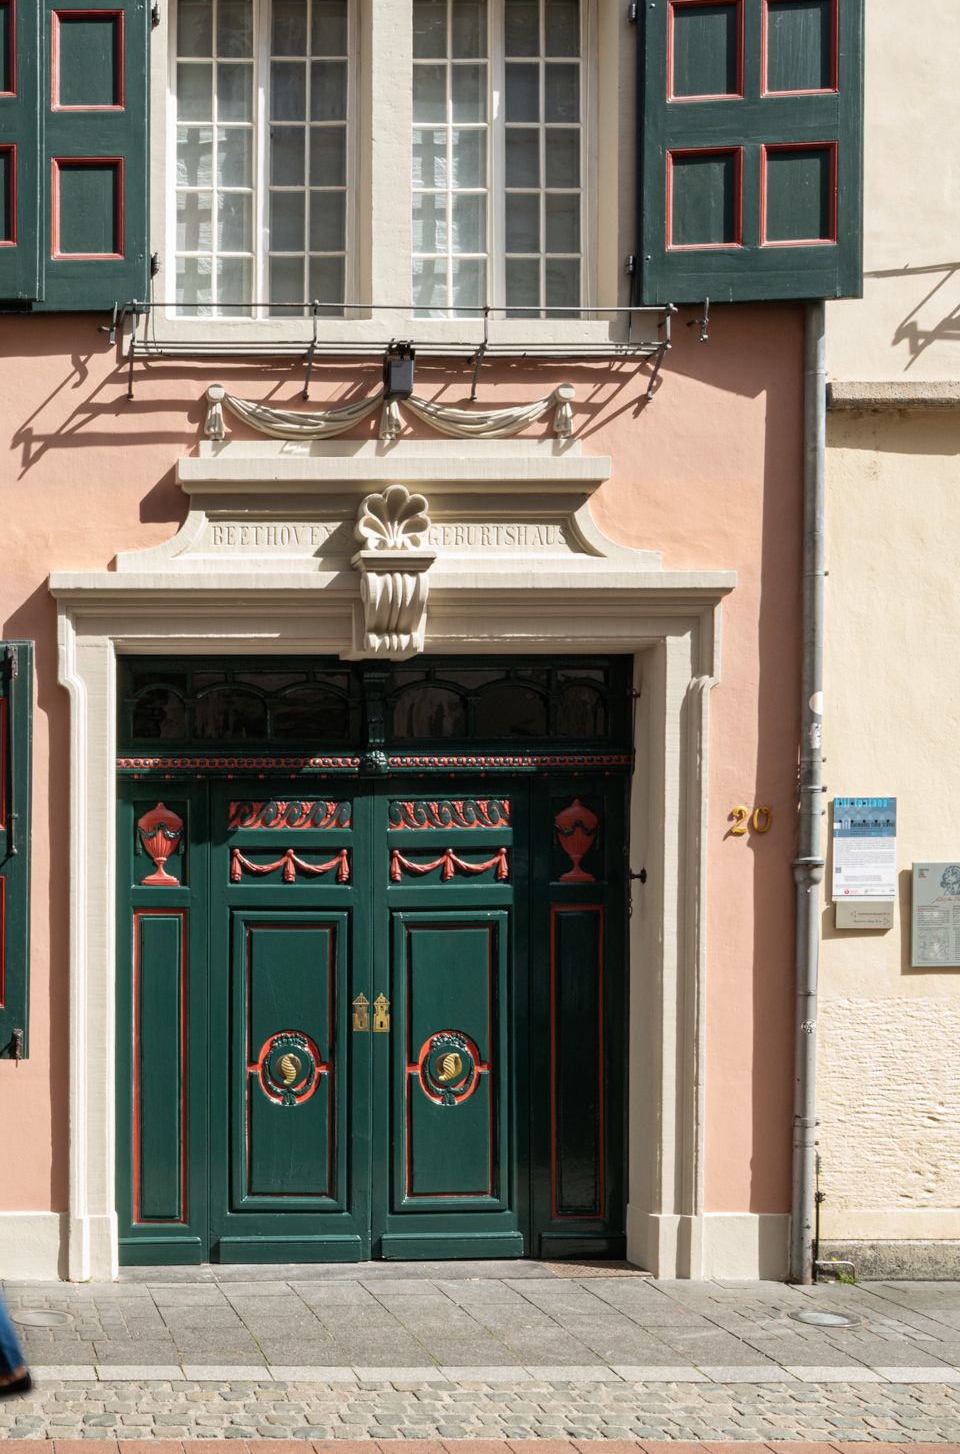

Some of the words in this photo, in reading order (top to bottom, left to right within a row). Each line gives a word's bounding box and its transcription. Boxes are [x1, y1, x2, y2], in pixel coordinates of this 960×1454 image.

[211, 525, 349, 547] BEETHOVENS
[427, 525, 568, 547] GEBURTSHAUS
[727, 805, 772, 834] 20
